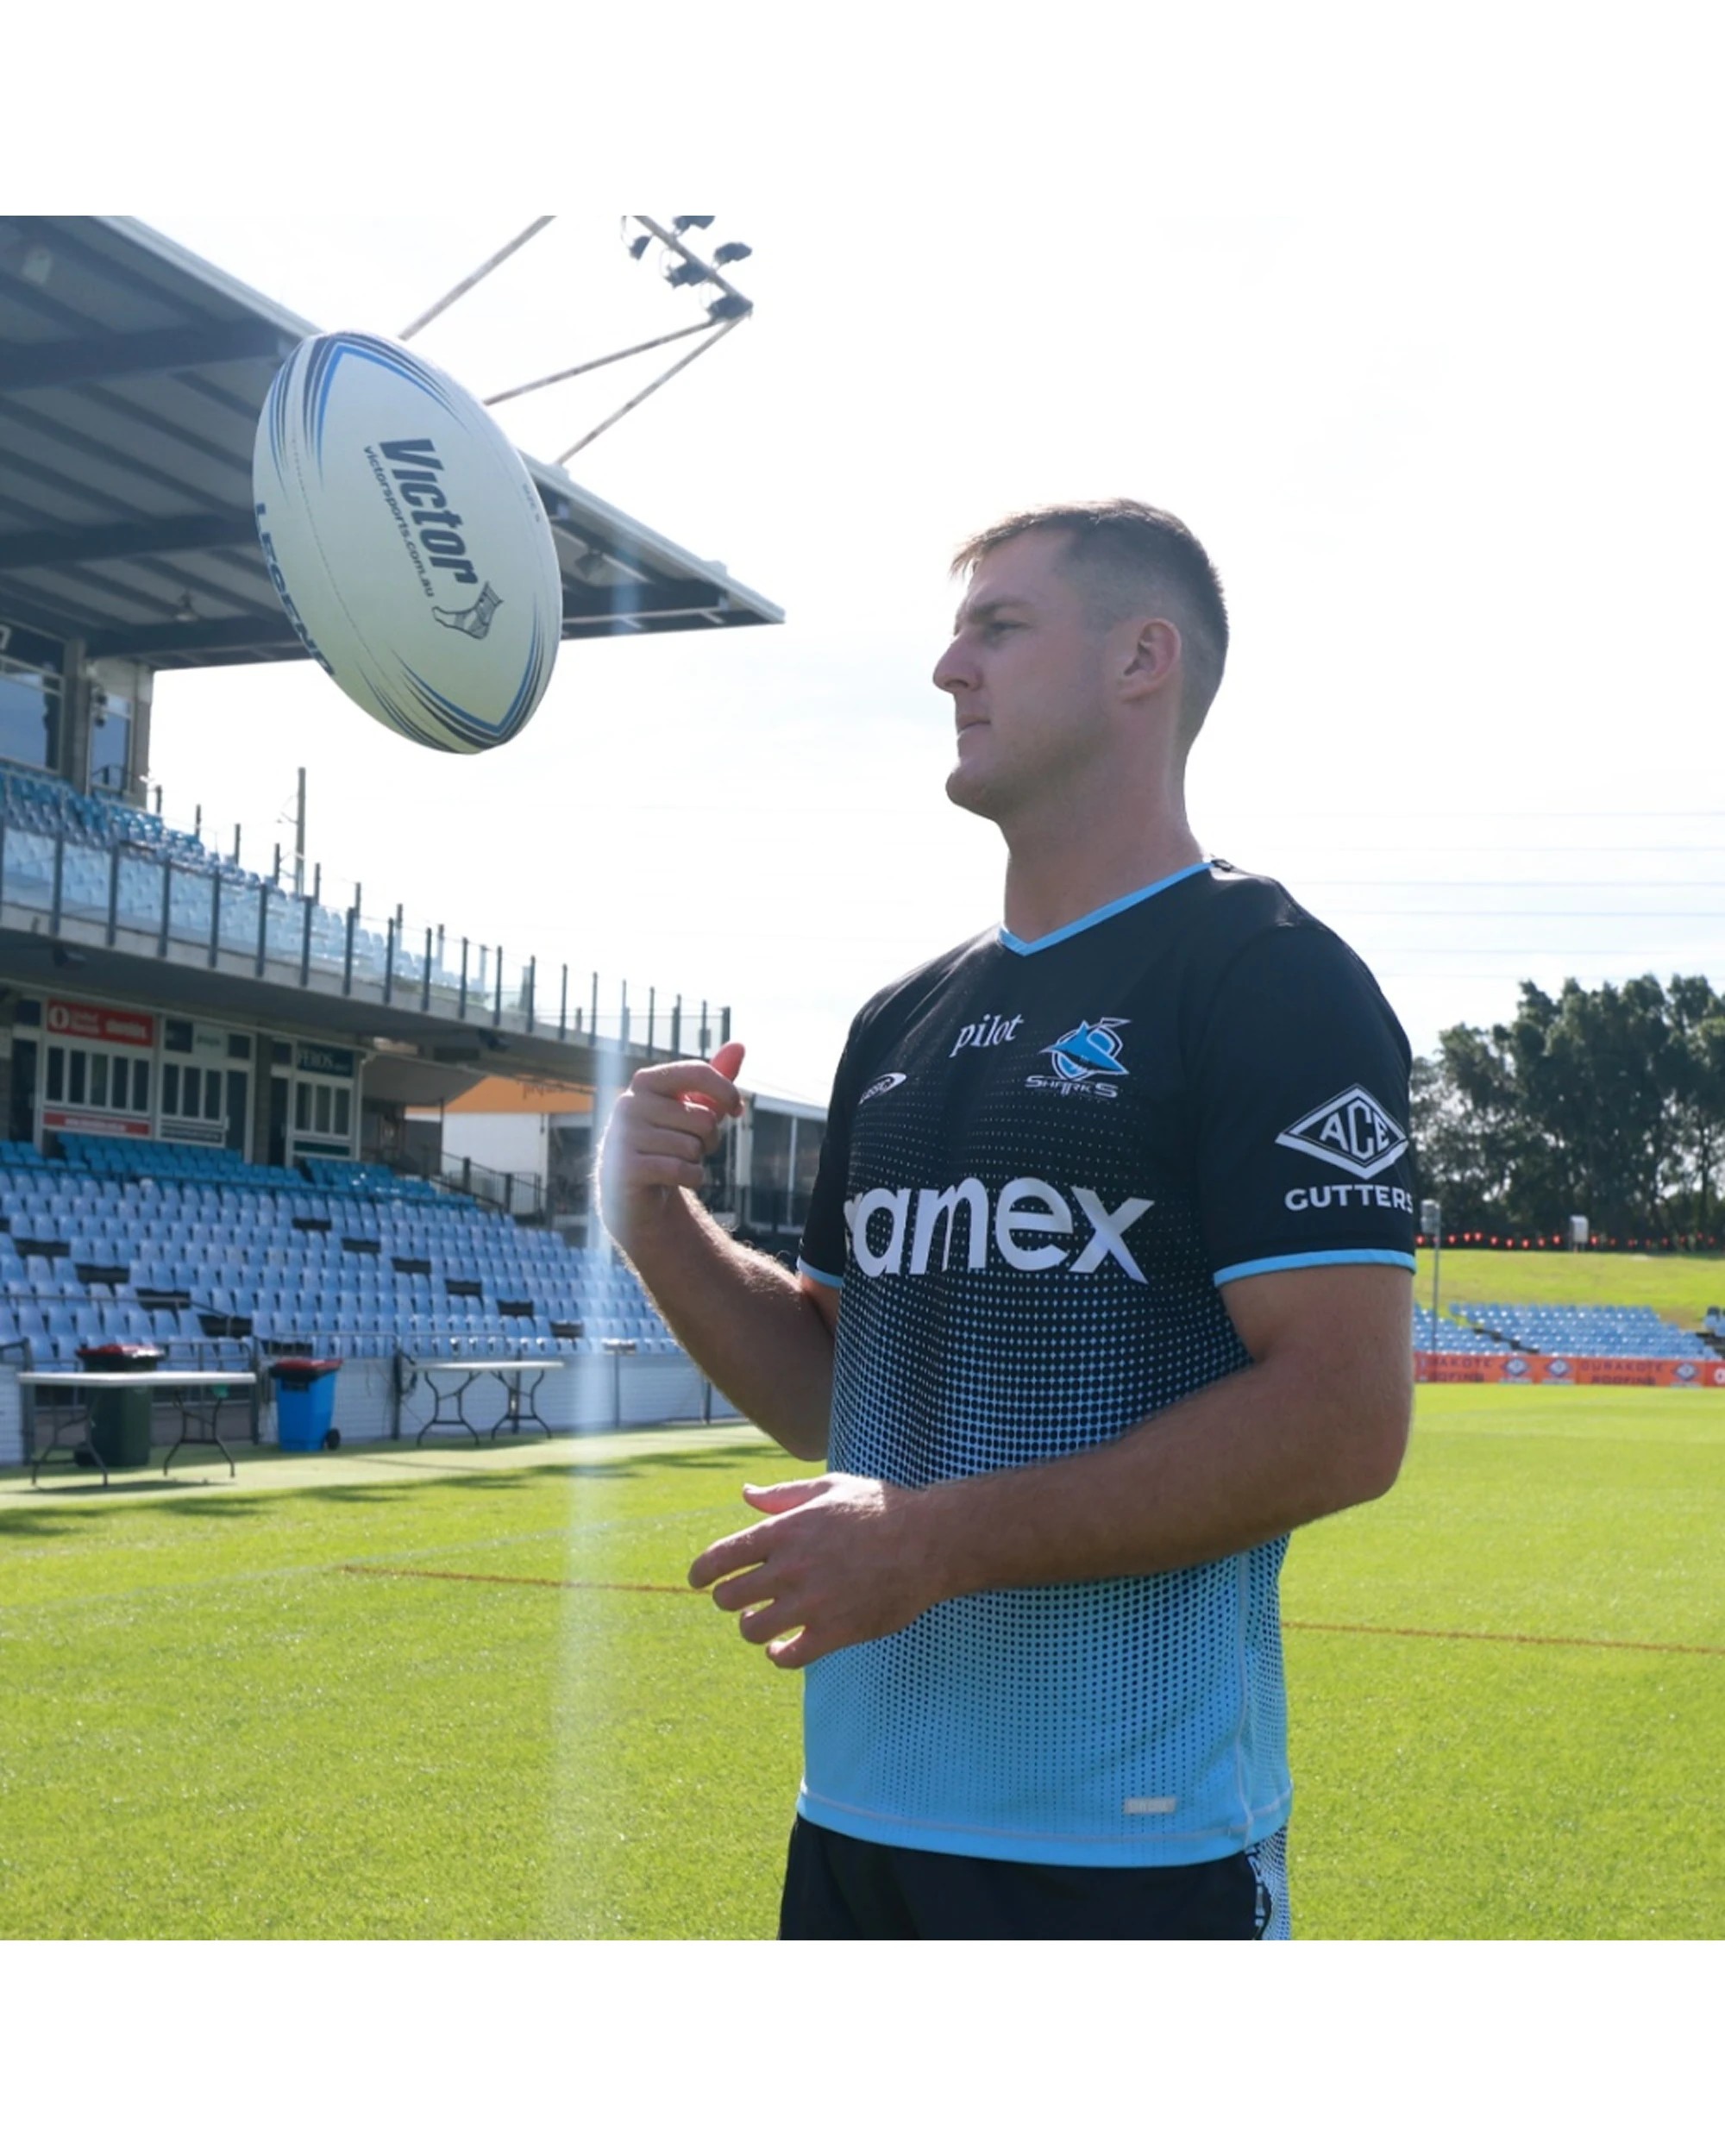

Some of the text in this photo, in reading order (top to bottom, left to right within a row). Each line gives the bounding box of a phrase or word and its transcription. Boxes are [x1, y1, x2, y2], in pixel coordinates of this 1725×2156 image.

[363, 445, 435, 598] victorsports.com.au
[380, 438, 478, 585] Victor
[950, 1013, 1025, 1058] pilot
[1025, 1075, 1119, 1098] SHARKS
[1320, 1100, 1389, 1161] ACE
